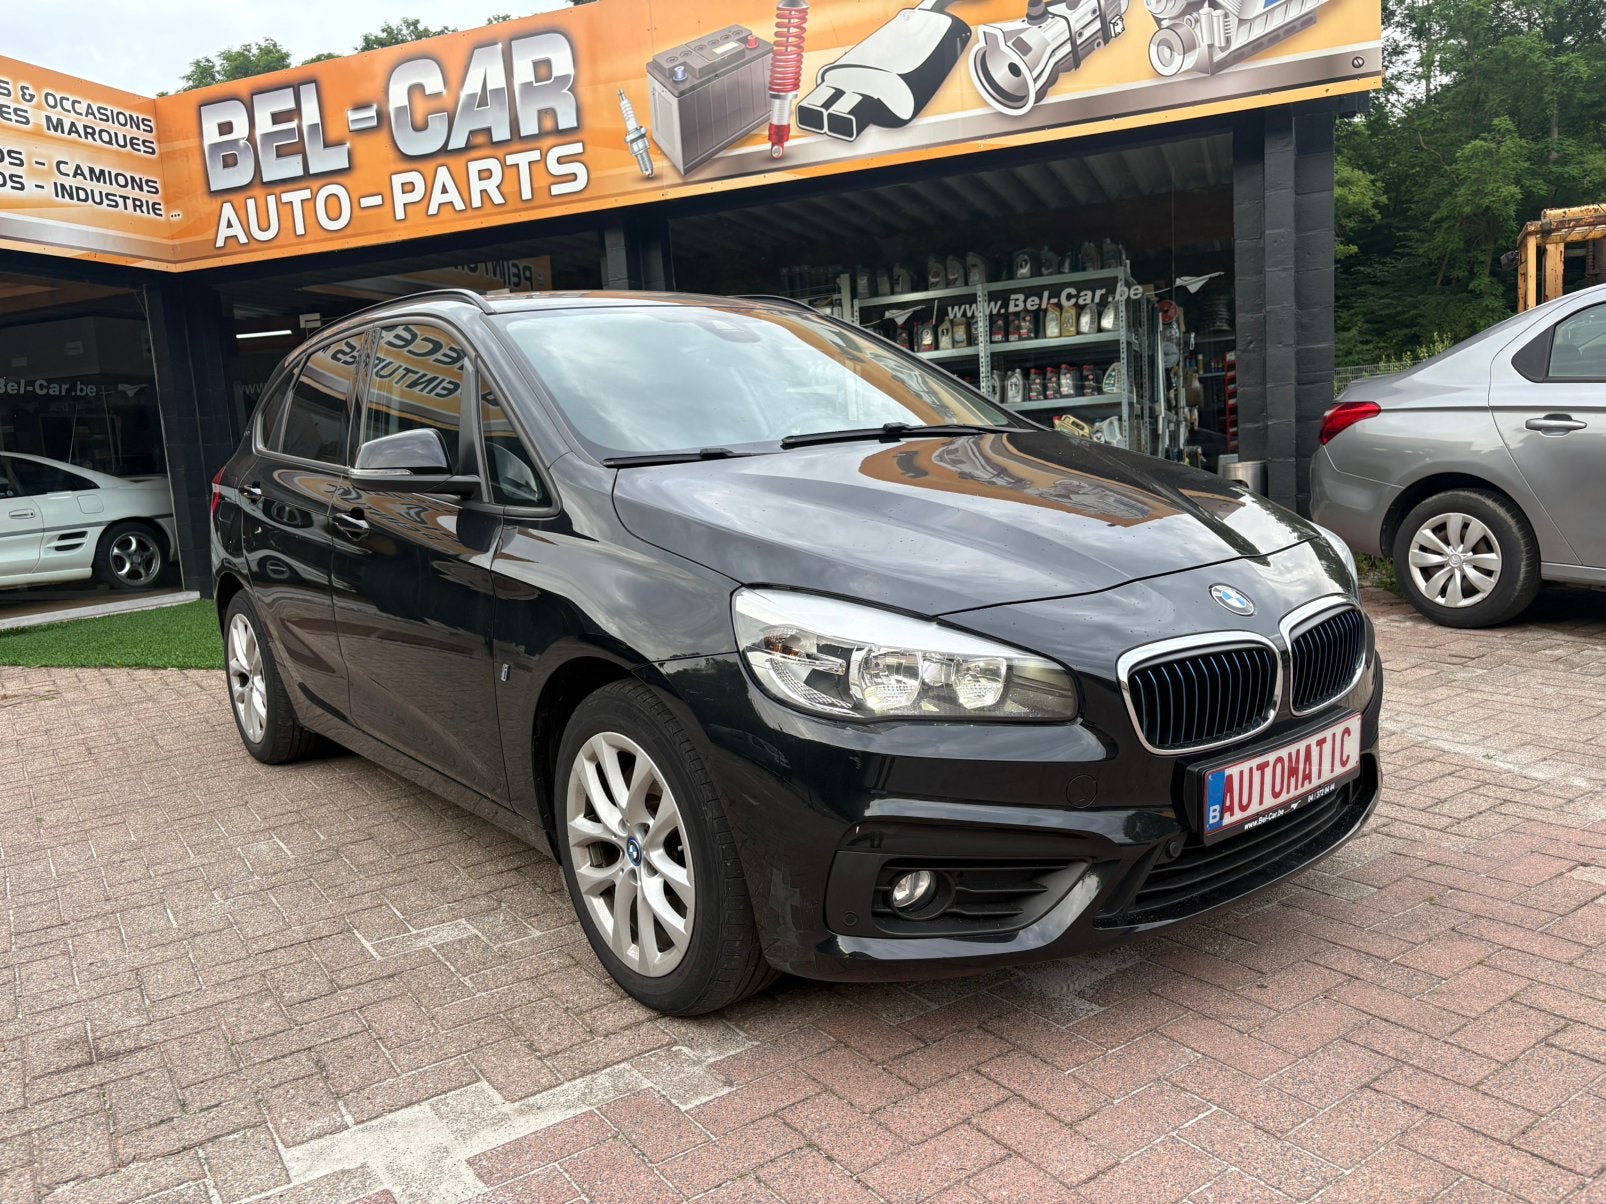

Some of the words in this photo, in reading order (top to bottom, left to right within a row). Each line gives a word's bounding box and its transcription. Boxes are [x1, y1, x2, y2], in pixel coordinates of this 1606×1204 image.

[20, 85, 36, 103] &
[43, 91, 154, 134] OCCASIONS
[200, 32, 578, 191] BEL-CAR
[44, 114, 157, 156] MARQUES
[55, 159, 160, 195] CAMIONS
[53, 181, 163, 217] INDUSTRIE
[1223, 727, 1351, 821] AUTOMATIC
[1208, 804, 1220, 824] B
[1244, 808, 1285, 831] www.Bel-Car.be
